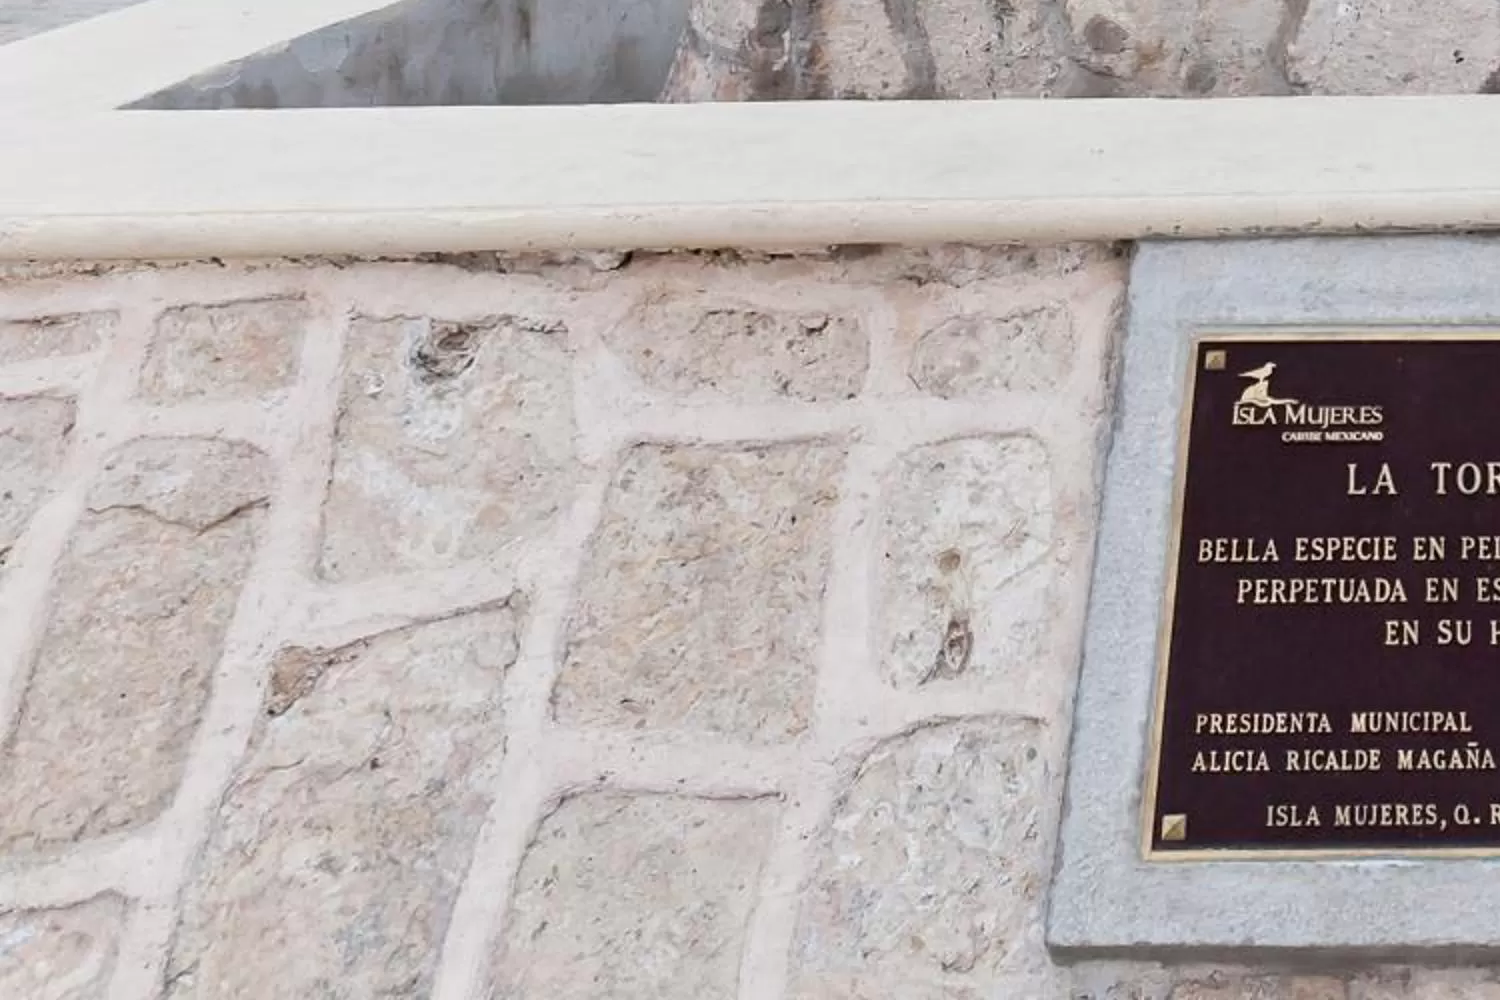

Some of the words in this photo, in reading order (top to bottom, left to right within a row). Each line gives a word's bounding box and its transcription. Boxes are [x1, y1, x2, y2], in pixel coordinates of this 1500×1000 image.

[1231, 401, 1279, 425] ISLA
[1282, 401, 1383, 429] MUJERES
[1347, 462, 1398, 495] LA
[1198, 537, 1280, 563] BELLA
[1295, 536, 1397, 562] ESPECIE
[1413, 535, 1446, 561] EN
[1236, 577, 1408, 604] PERPETUADA
[1425, 577, 1459, 603] EN
[1384, 619, 1419, 646] EN
[1437, 619, 1472, 646] SU
[1195, 711, 1333, 734] PRESIDENTA
[1350, 711, 1473, 733] MUNICIPAL
[1191, 749, 1271, 772] ALICIA
[1285, 748, 1381, 771] RICALDE
[1397, 741, 1497, 771] MAGAÑA
[1266, 805, 1321, 827] ISLA
[1334, 803, 1447, 831] MUJERES,
[1453, 803, 1481, 825] Q.
